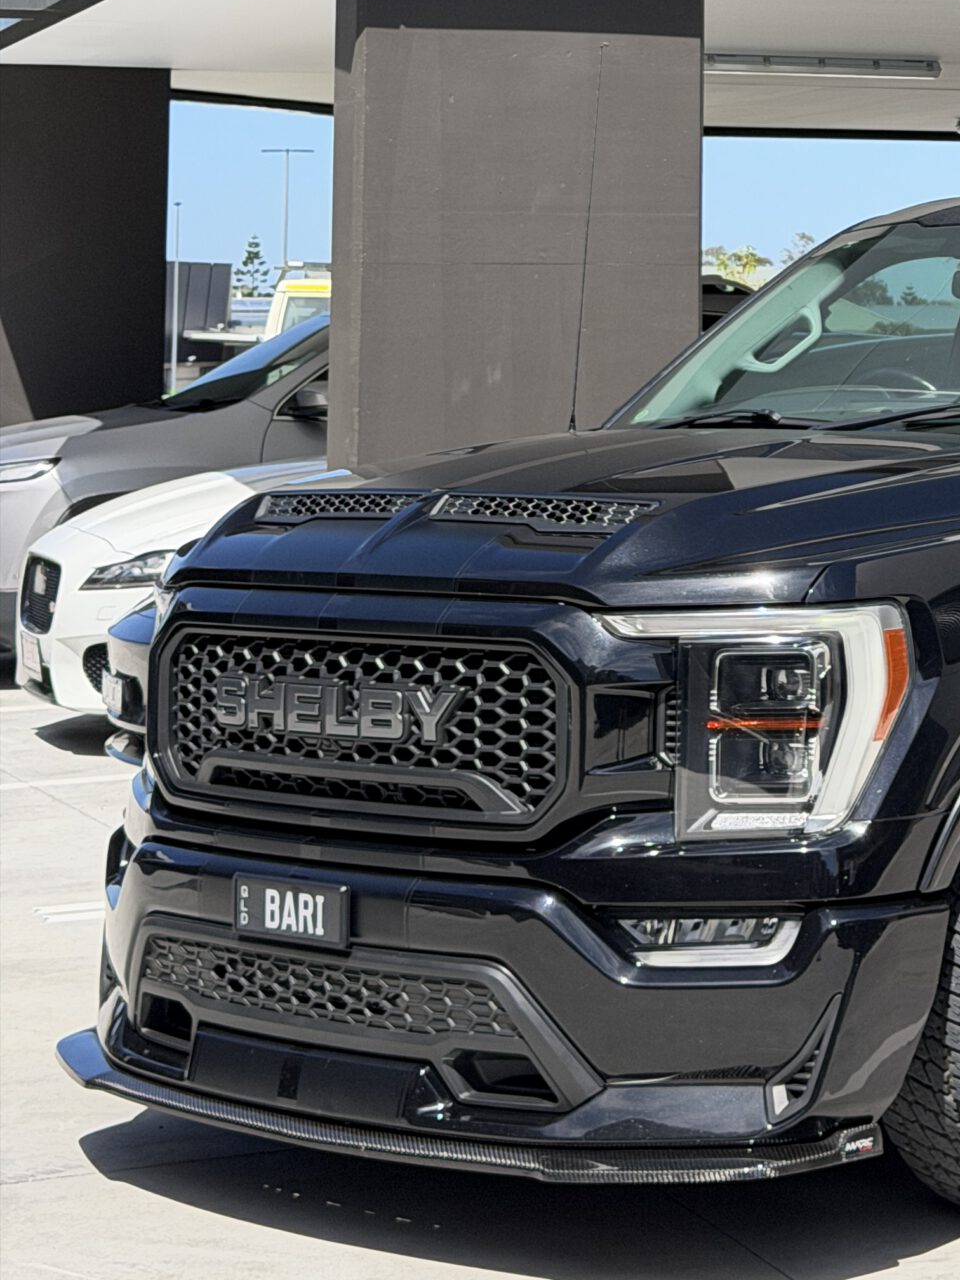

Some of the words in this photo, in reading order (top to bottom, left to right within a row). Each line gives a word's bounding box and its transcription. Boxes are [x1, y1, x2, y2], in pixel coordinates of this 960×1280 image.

[215, 674, 460, 743] SHELBY
[240, 885, 249, 925] QLD
[264, 888, 325, 936] BARI
